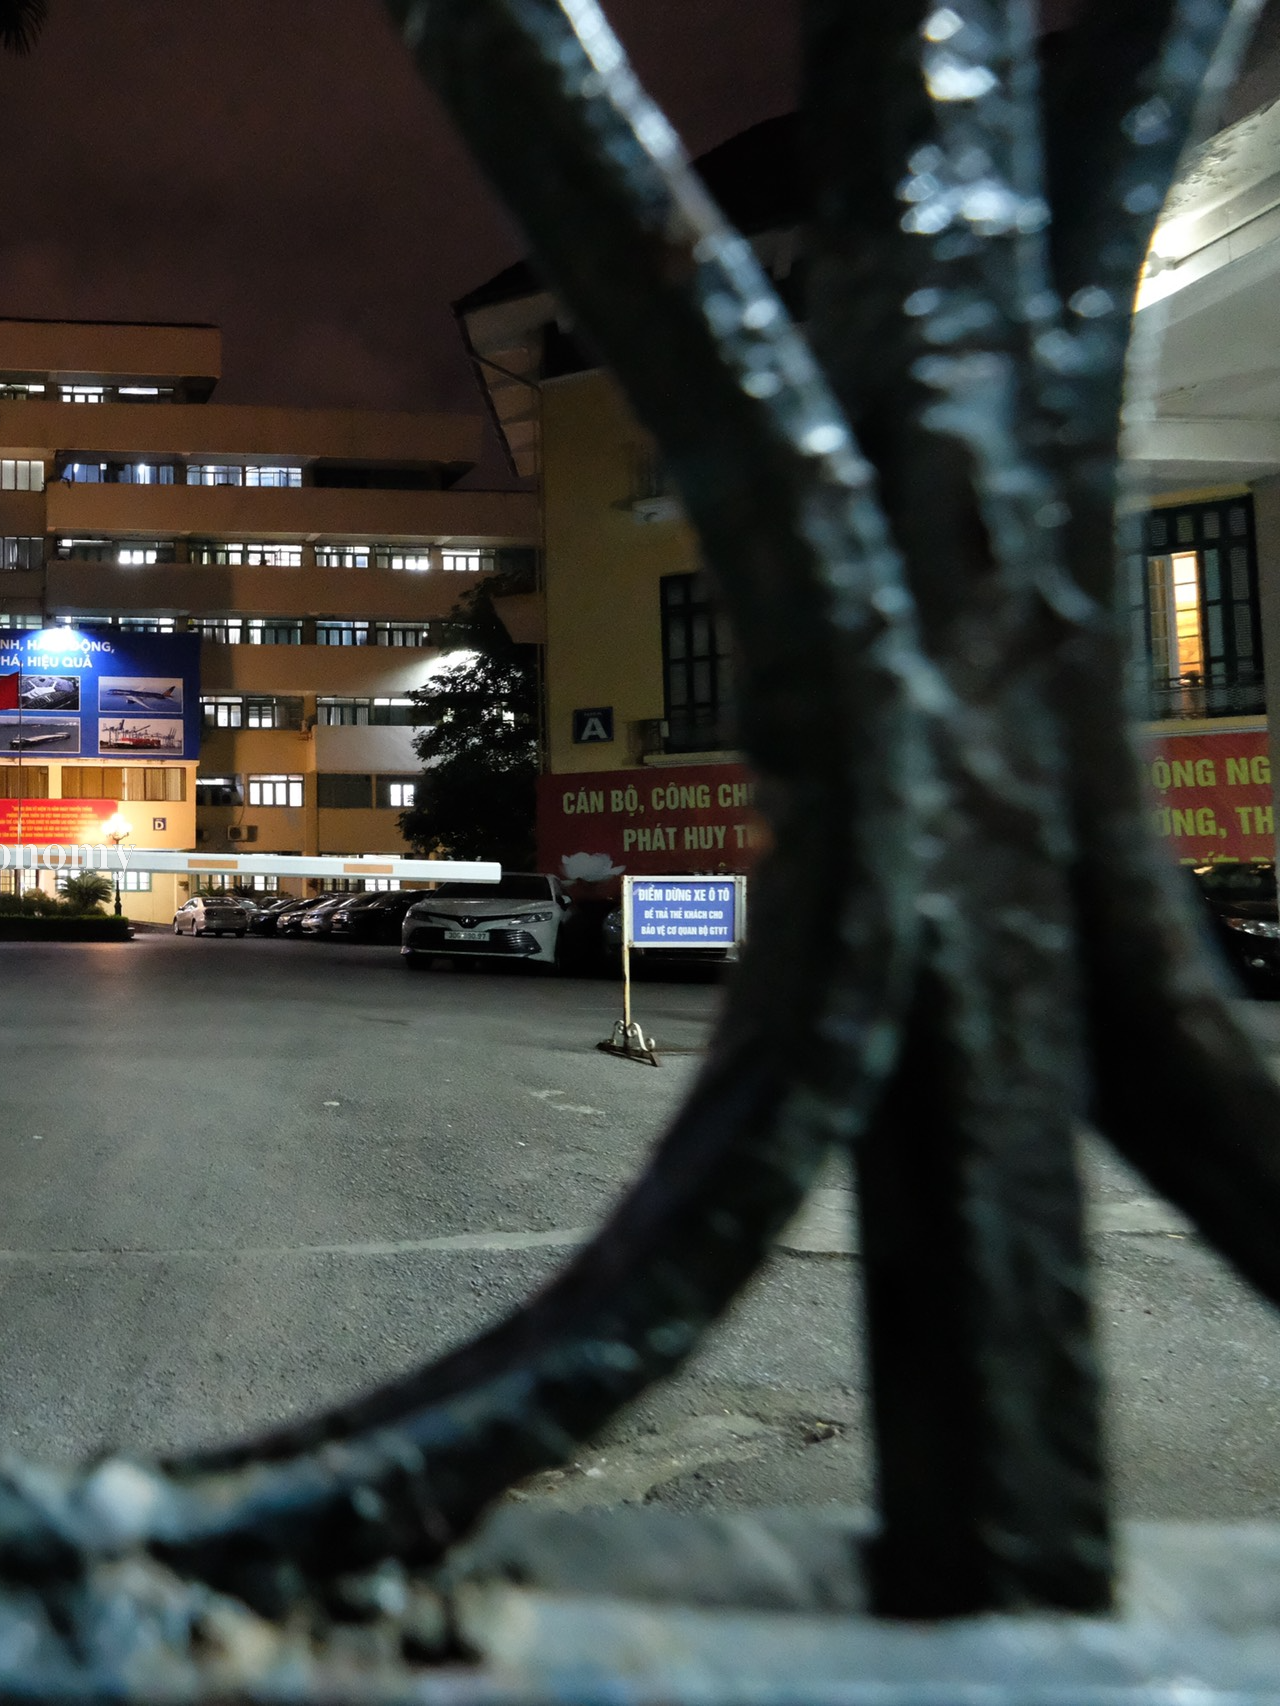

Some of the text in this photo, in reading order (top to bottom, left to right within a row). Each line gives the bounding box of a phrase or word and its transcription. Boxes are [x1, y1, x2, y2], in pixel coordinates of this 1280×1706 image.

[27, 653, 59, 670] HIỆU
[62, 654, 93, 668] QUẢ
[581, 717, 609, 740] A
[1146, 755, 1217, 795] ỘNG
[610, 784, 645, 817] BỘ,
[651, 782, 712, 811] CÔNG
[155, 820, 165, 830] D
[623, 822, 678, 852] PHÁT
[684, 824, 727, 850] HUY
[638, 884, 730, 902] ĐIỂM DỪNG XE Ô TÔ
[684, 908, 708, 919] KHÁCH
[708, 910, 723, 919] CHO
[678, 926, 697, 936] QUAN
[709, 926, 728, 935] GTVT
